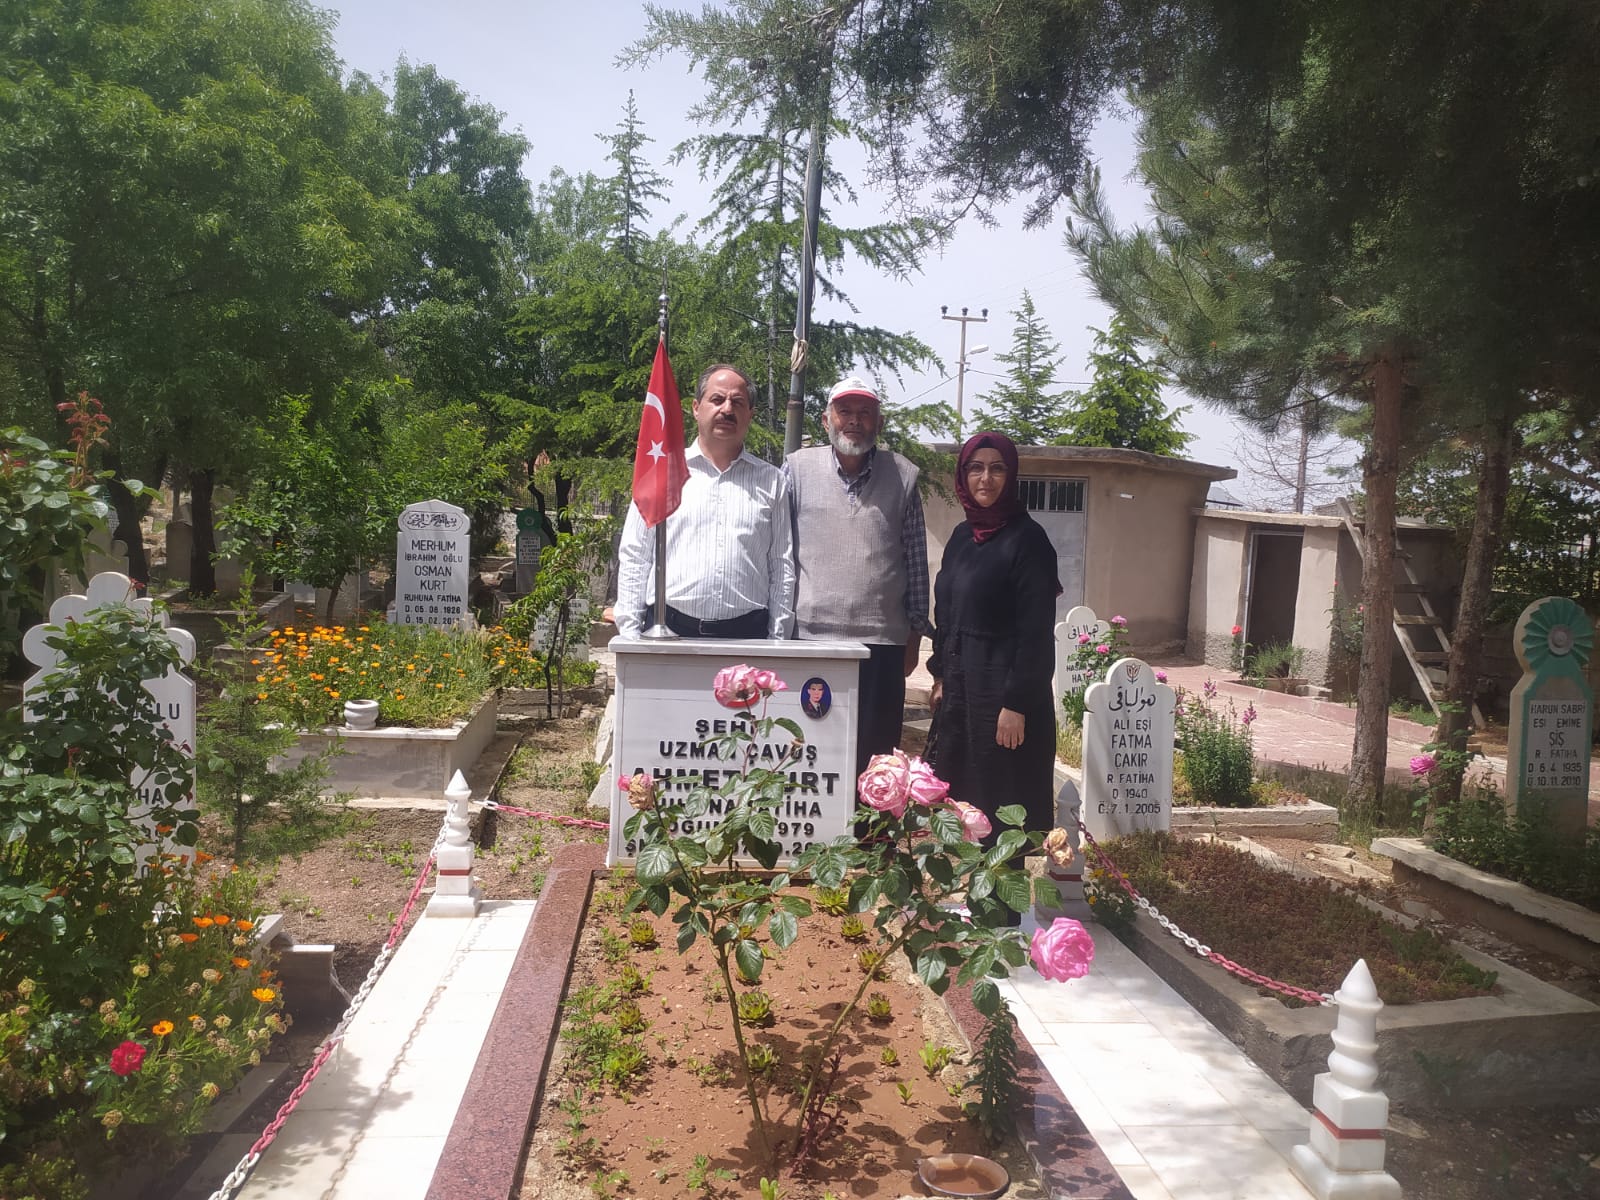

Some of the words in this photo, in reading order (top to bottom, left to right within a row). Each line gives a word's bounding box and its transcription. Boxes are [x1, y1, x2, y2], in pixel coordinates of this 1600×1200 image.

[411, 540, 456, 551] MERHUM
[442, 553, 463, 563] OĞLU
[414, 565, 452, 577] OSMAN
[420, 579, 447, 591] KURT
[404, 593, 434, 602] RUHUNA
[1530, 703, 1559, 714] HARUN
[695, 715, 760, 740] ŞEHİ
[1111, 734, 1152, 749] FATMA
[659, 740, 737, 760] UZMA
[760, 770, 840, 796] URT
[1126, 788, 1148, 799] 1940
